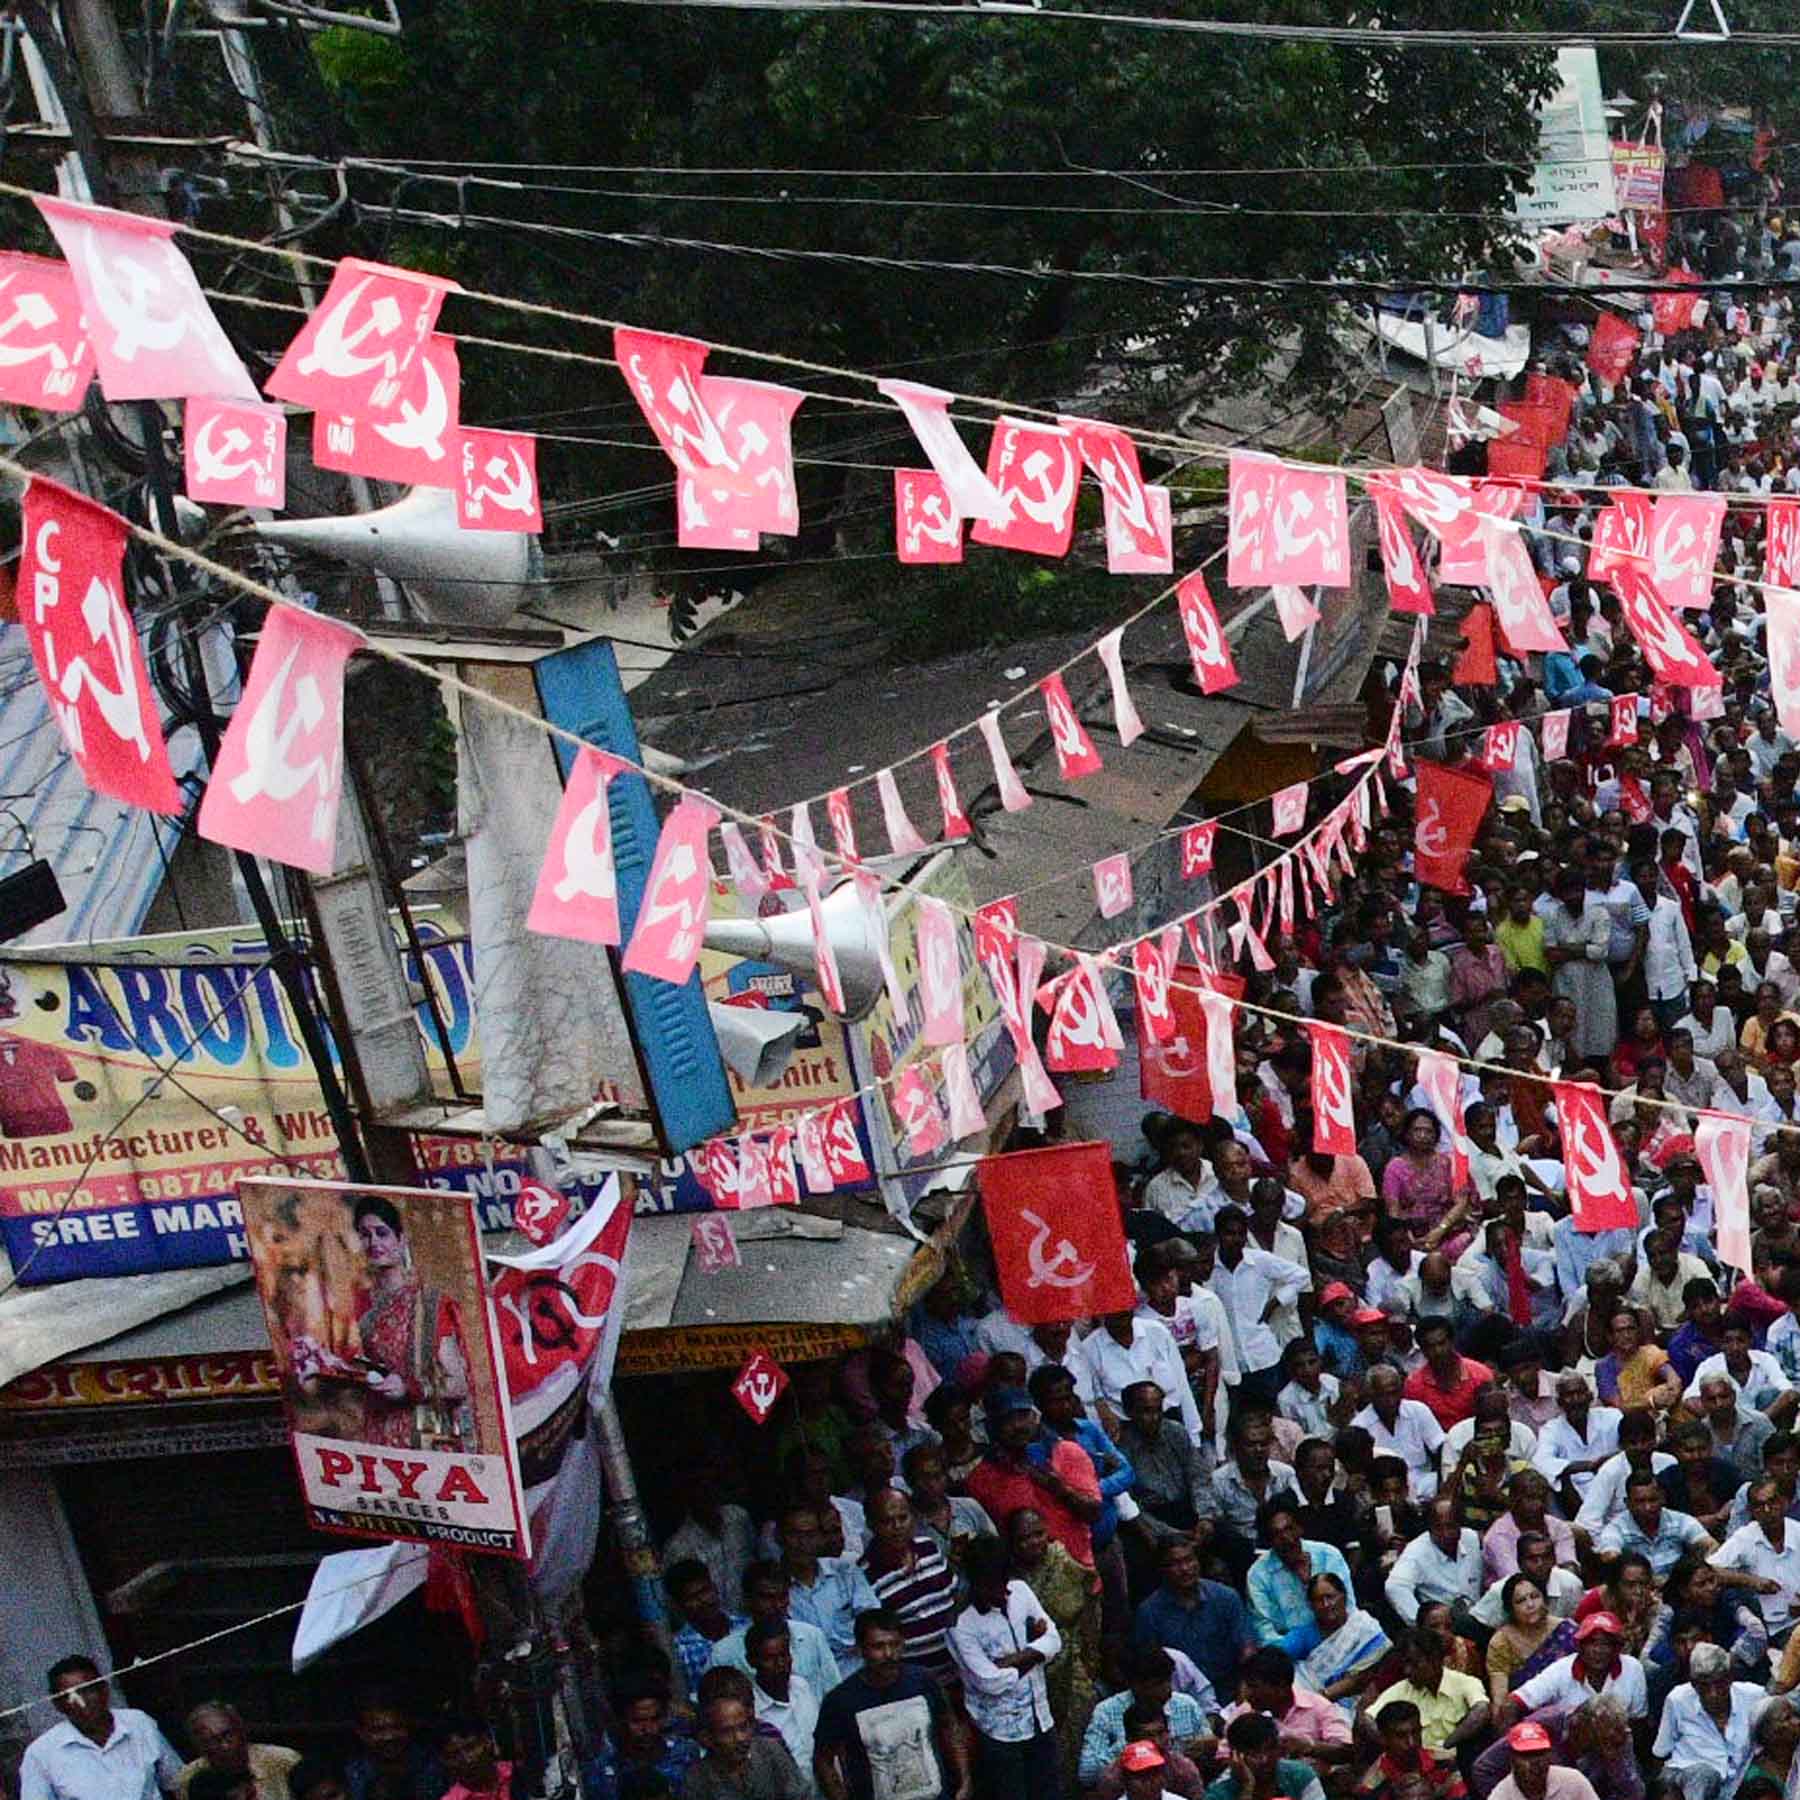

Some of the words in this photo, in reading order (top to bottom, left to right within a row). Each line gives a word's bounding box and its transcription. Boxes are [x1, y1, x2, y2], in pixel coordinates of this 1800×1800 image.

[1, 1122, 231, 1172] Manufacturer
[243, 1114, 267, 1146] &
[31, 1210, 141, 1248] SREE
[315, 1448, 489, 1504] PIYA
[356, 1496, 451, 1521] SAREES
[424, 1524, 515, 1549] PRODUCT
